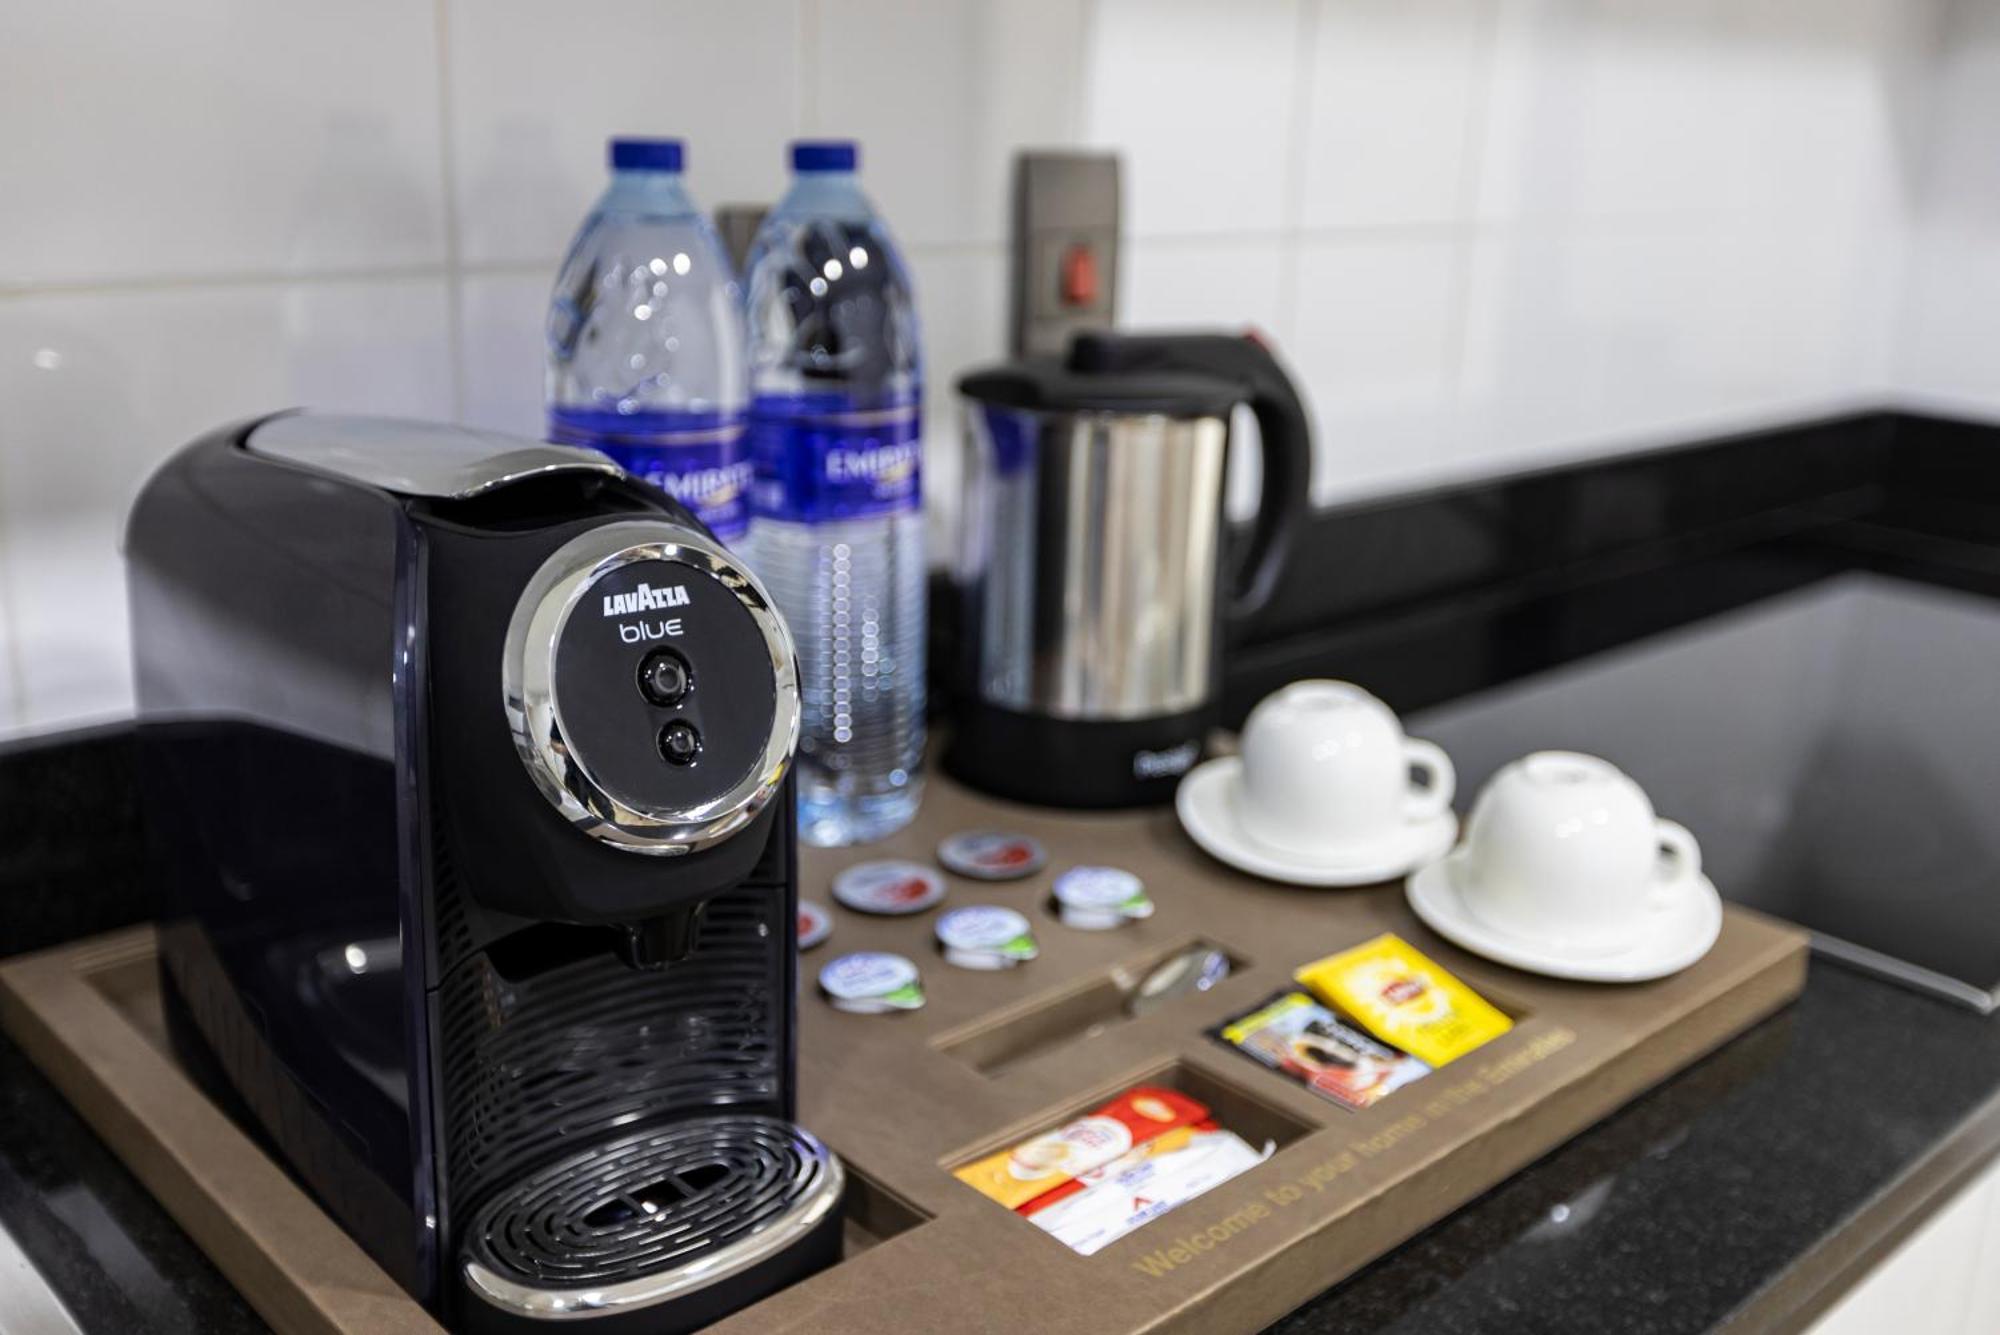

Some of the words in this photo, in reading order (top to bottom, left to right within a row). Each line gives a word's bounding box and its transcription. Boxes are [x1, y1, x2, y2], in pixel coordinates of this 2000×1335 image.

[603, 583, 691, 616] LAVAZZA
[619, 618, 684, 643] blue
[1132, 1203, 1271, 1278] Welcome
[1264, 1183, 1302, 1207] to
[1300, 1152, 1356, 1192] your
[1351, 1114, 1427, 1157] home
